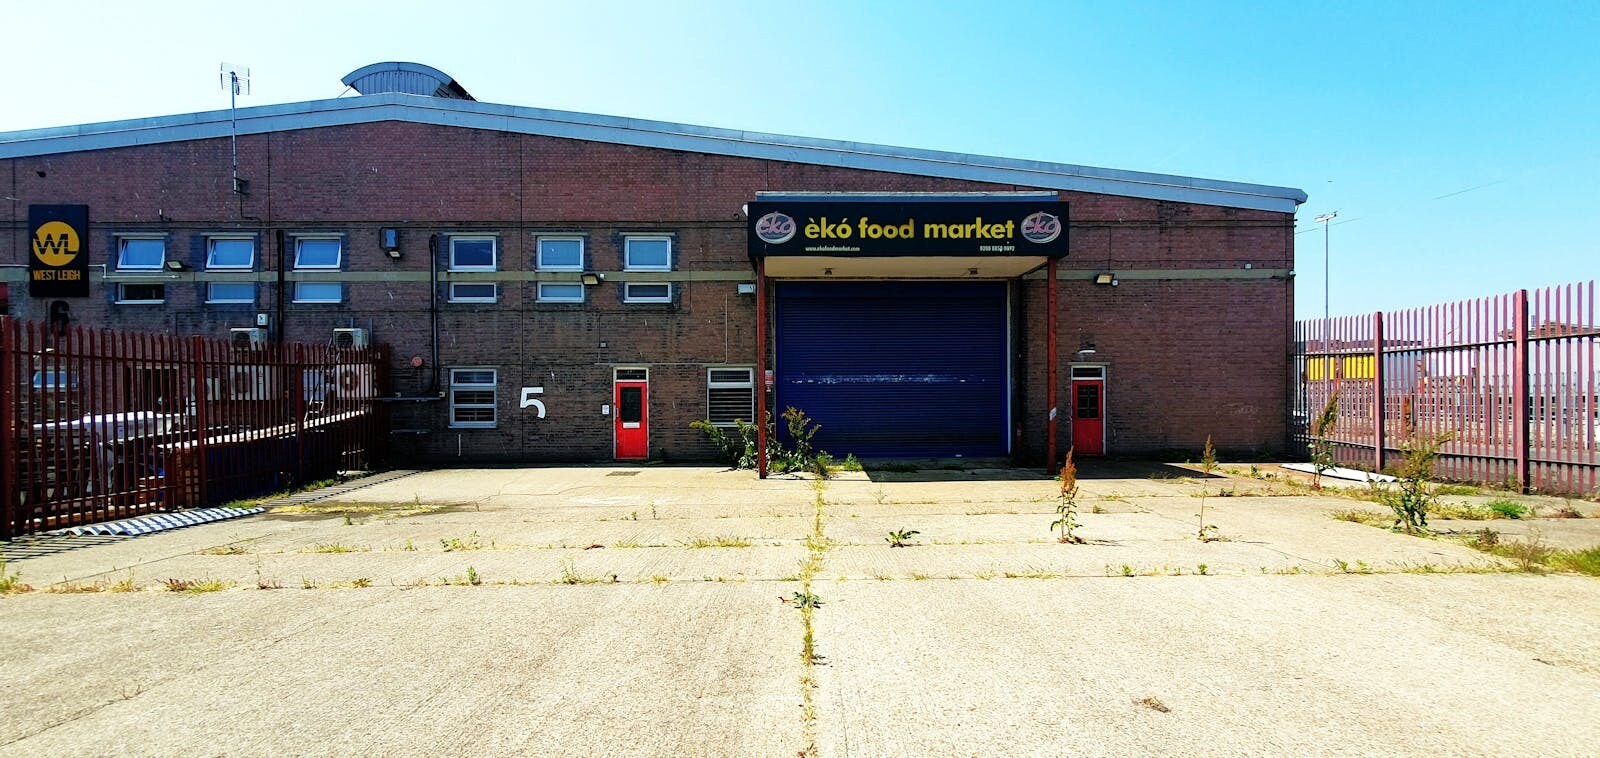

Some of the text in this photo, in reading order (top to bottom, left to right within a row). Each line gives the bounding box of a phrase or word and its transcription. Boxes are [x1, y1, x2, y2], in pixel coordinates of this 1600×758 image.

[804, 217, 1014, 239] èkó food market
[33, 270, 80, 281] WEST LEIGH
[519, 386, 546, 419] 5
